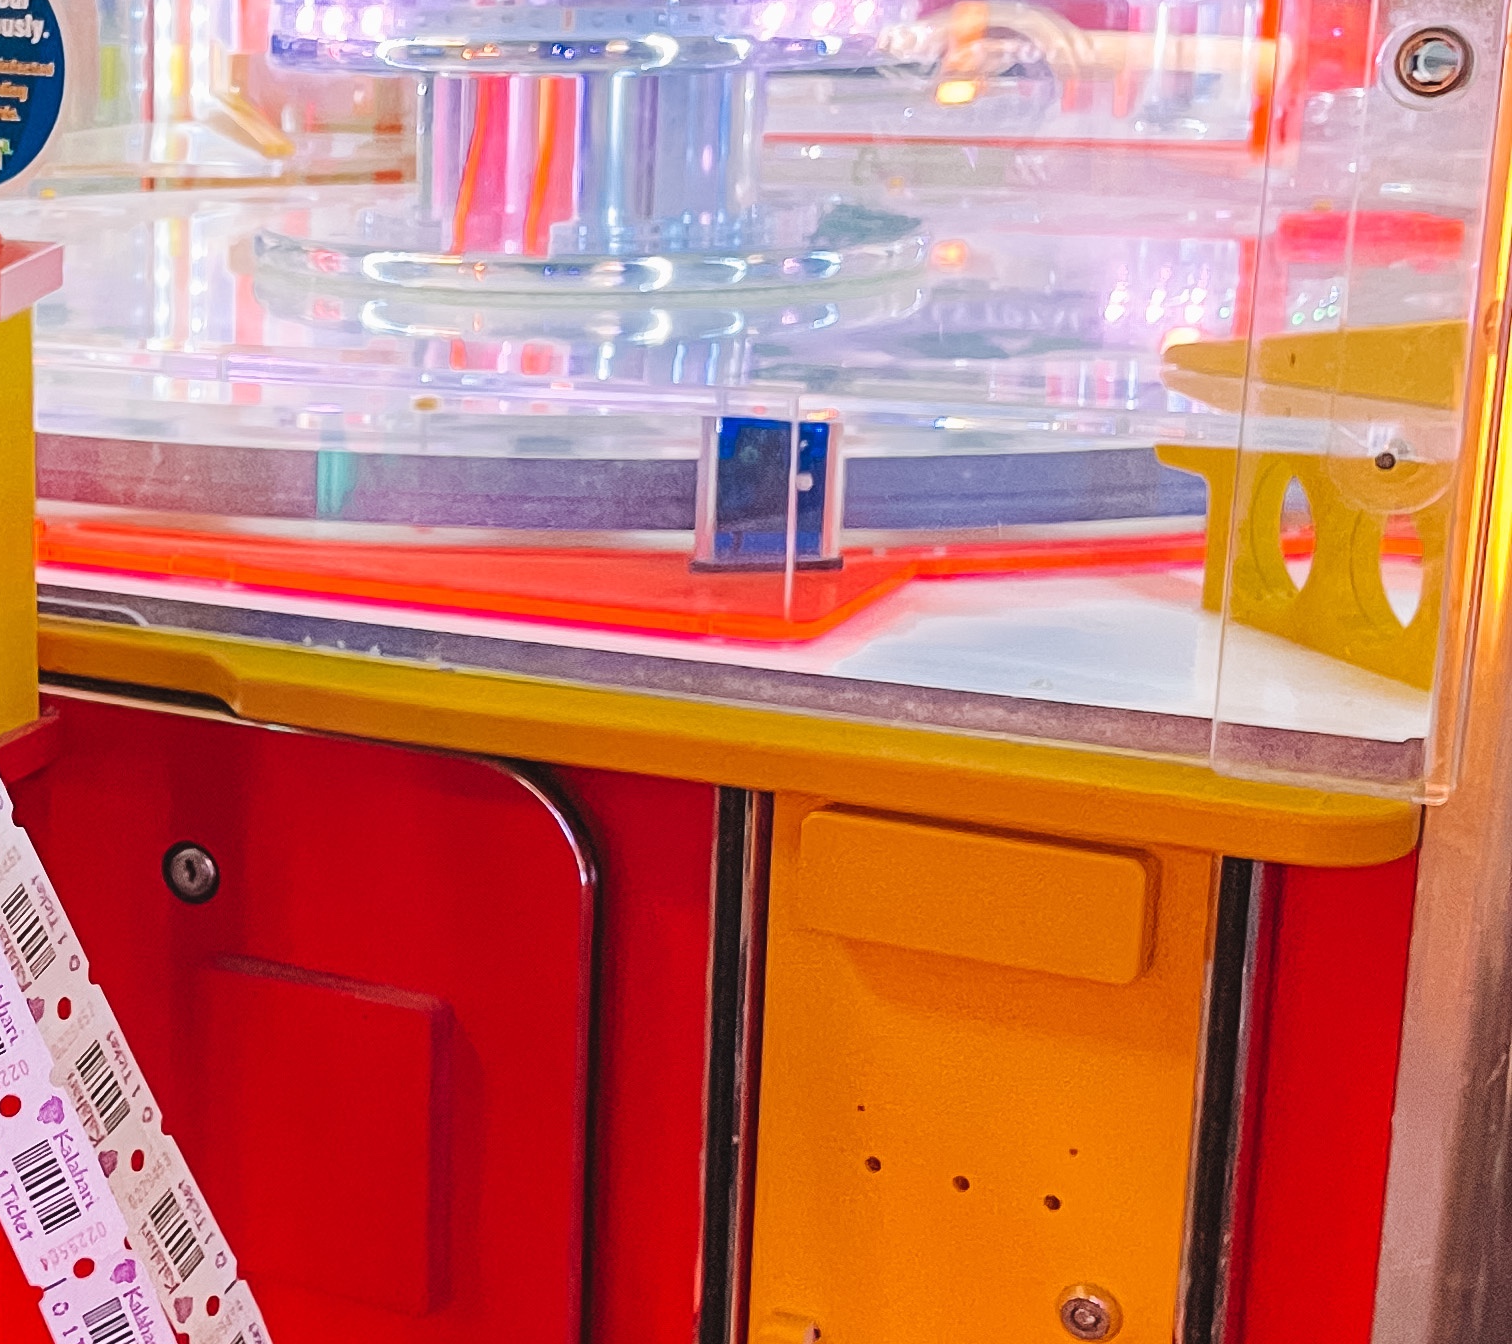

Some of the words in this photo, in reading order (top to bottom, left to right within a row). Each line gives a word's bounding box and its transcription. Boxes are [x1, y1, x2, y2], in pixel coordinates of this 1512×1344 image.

[52, 1126, 96, 1213] Kalahari
[0, 1184, 34, 1244] Ticket
[63, 1326, 79, 1340] 1
